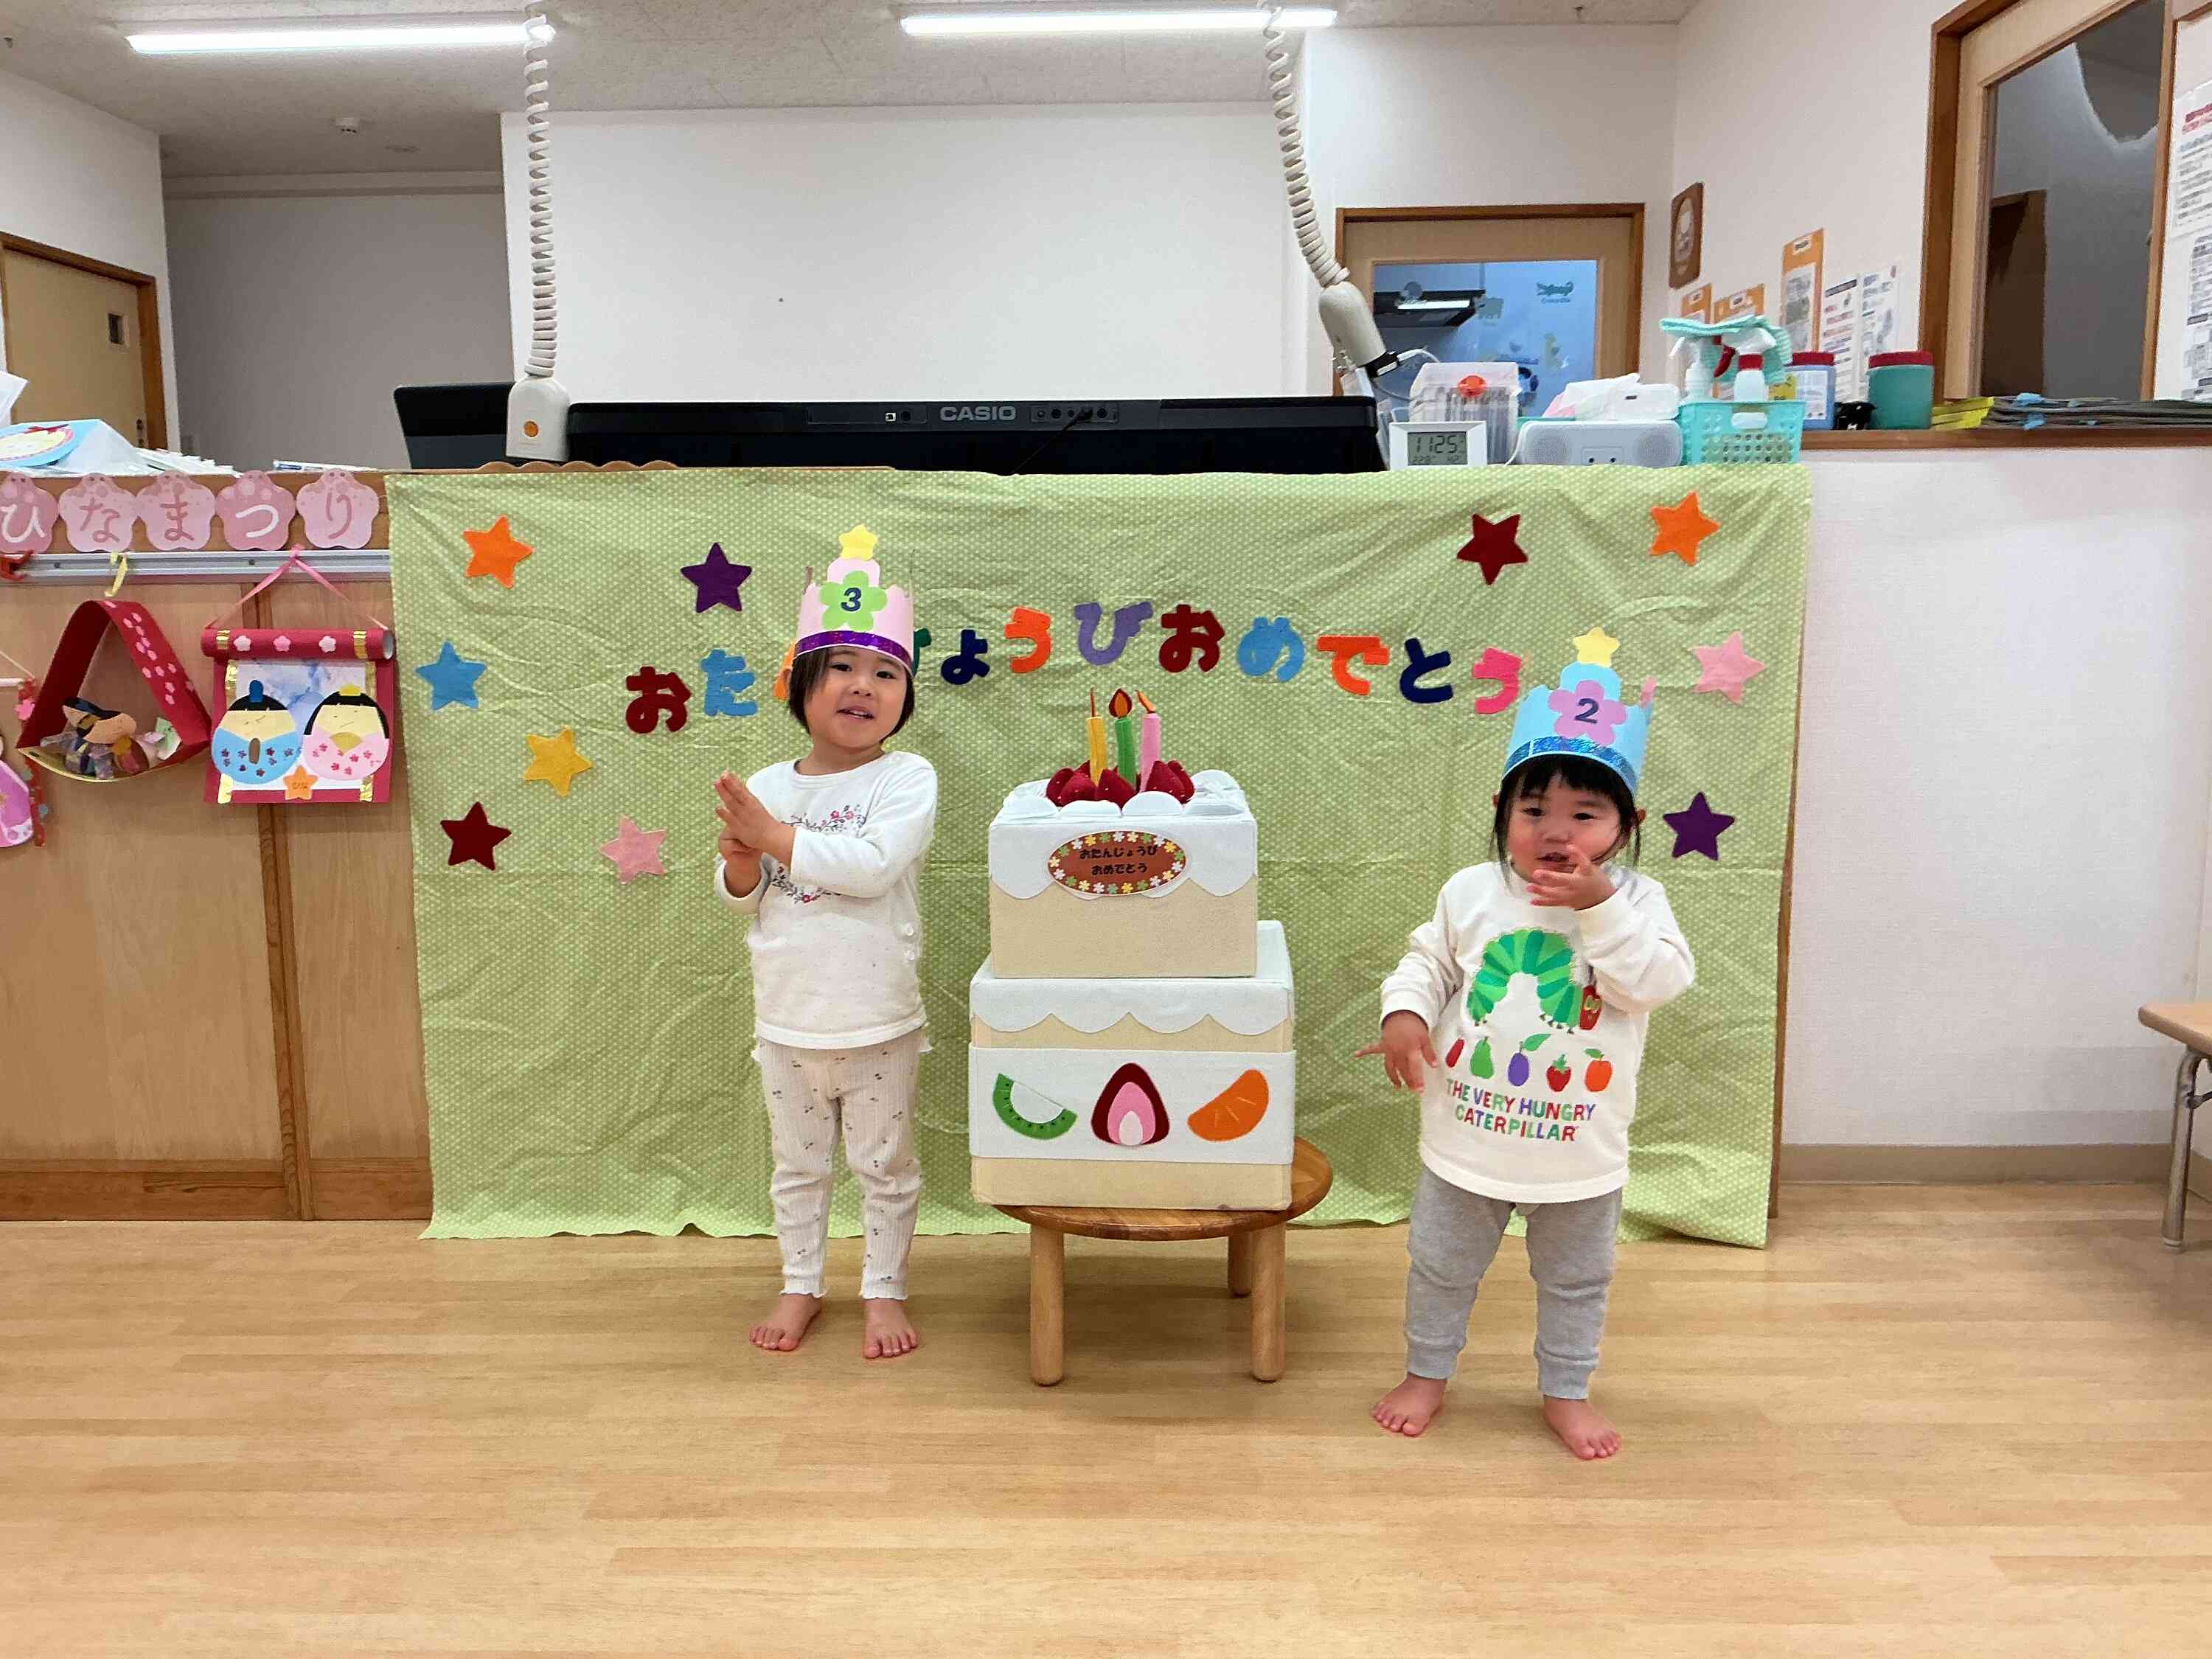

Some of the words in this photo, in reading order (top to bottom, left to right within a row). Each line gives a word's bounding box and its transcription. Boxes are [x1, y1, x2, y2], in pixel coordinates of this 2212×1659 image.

[940, 406, 1016, 421] CASIO
[0, 492, 354, 543] ひなまつり
[841, 587, 861, 612] 3
[1574, 698, 1599, 723] 2
[1079, 845, 1158, 859] おたんじょうび
[1091, 863, 1147, 875] おめでとう
[1446, 1079, 1471, 1102] THE
[1473, 1087, 1516, 1113] VERY
[1517, 1097, 1596, 1121] HUNGRY
[1455, 1104, 1576, 1141] CATERPILLAR
